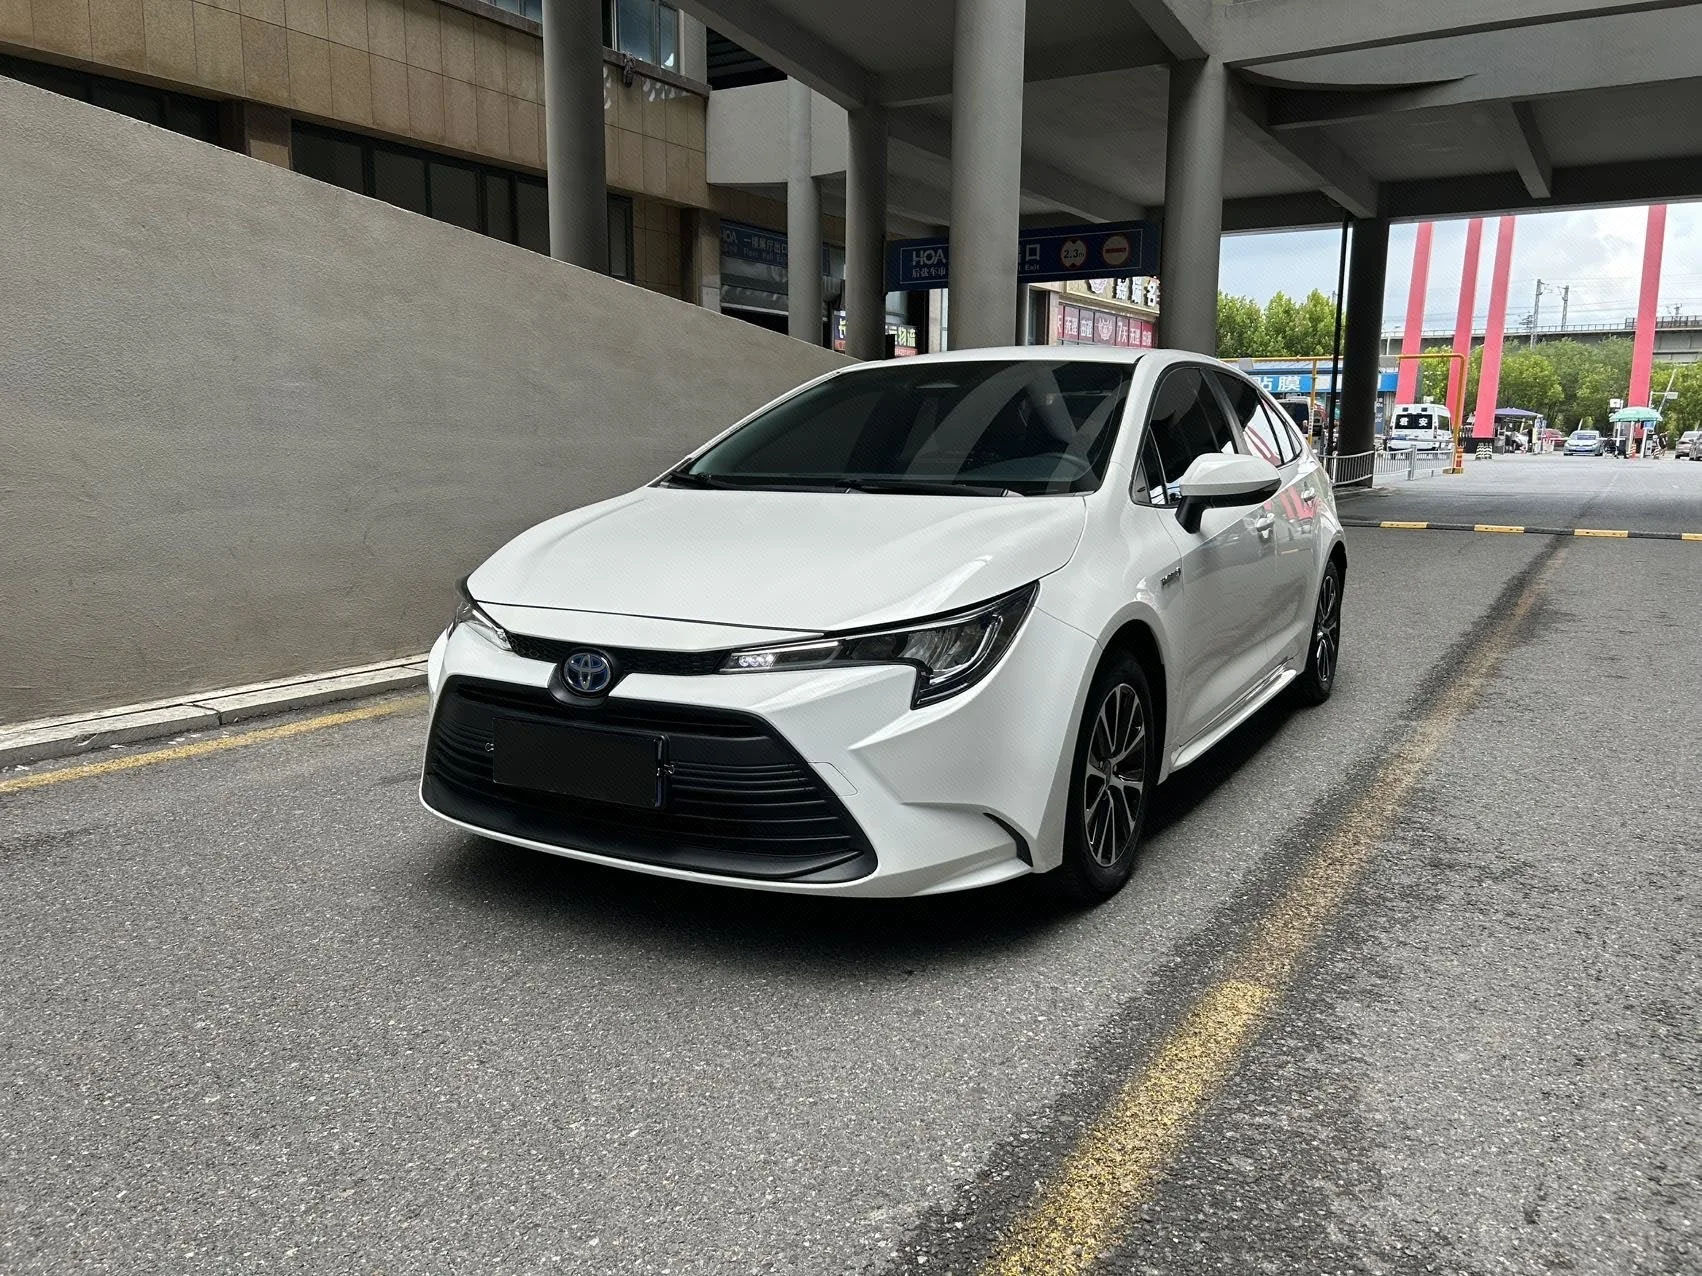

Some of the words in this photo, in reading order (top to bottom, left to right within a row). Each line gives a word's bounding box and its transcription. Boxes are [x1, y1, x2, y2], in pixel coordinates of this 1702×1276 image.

[912, 249, 946, 266] HOA
[1064, 248, 1084, 259] 2.3m
[1024, 263, 1040, 271] Exit
